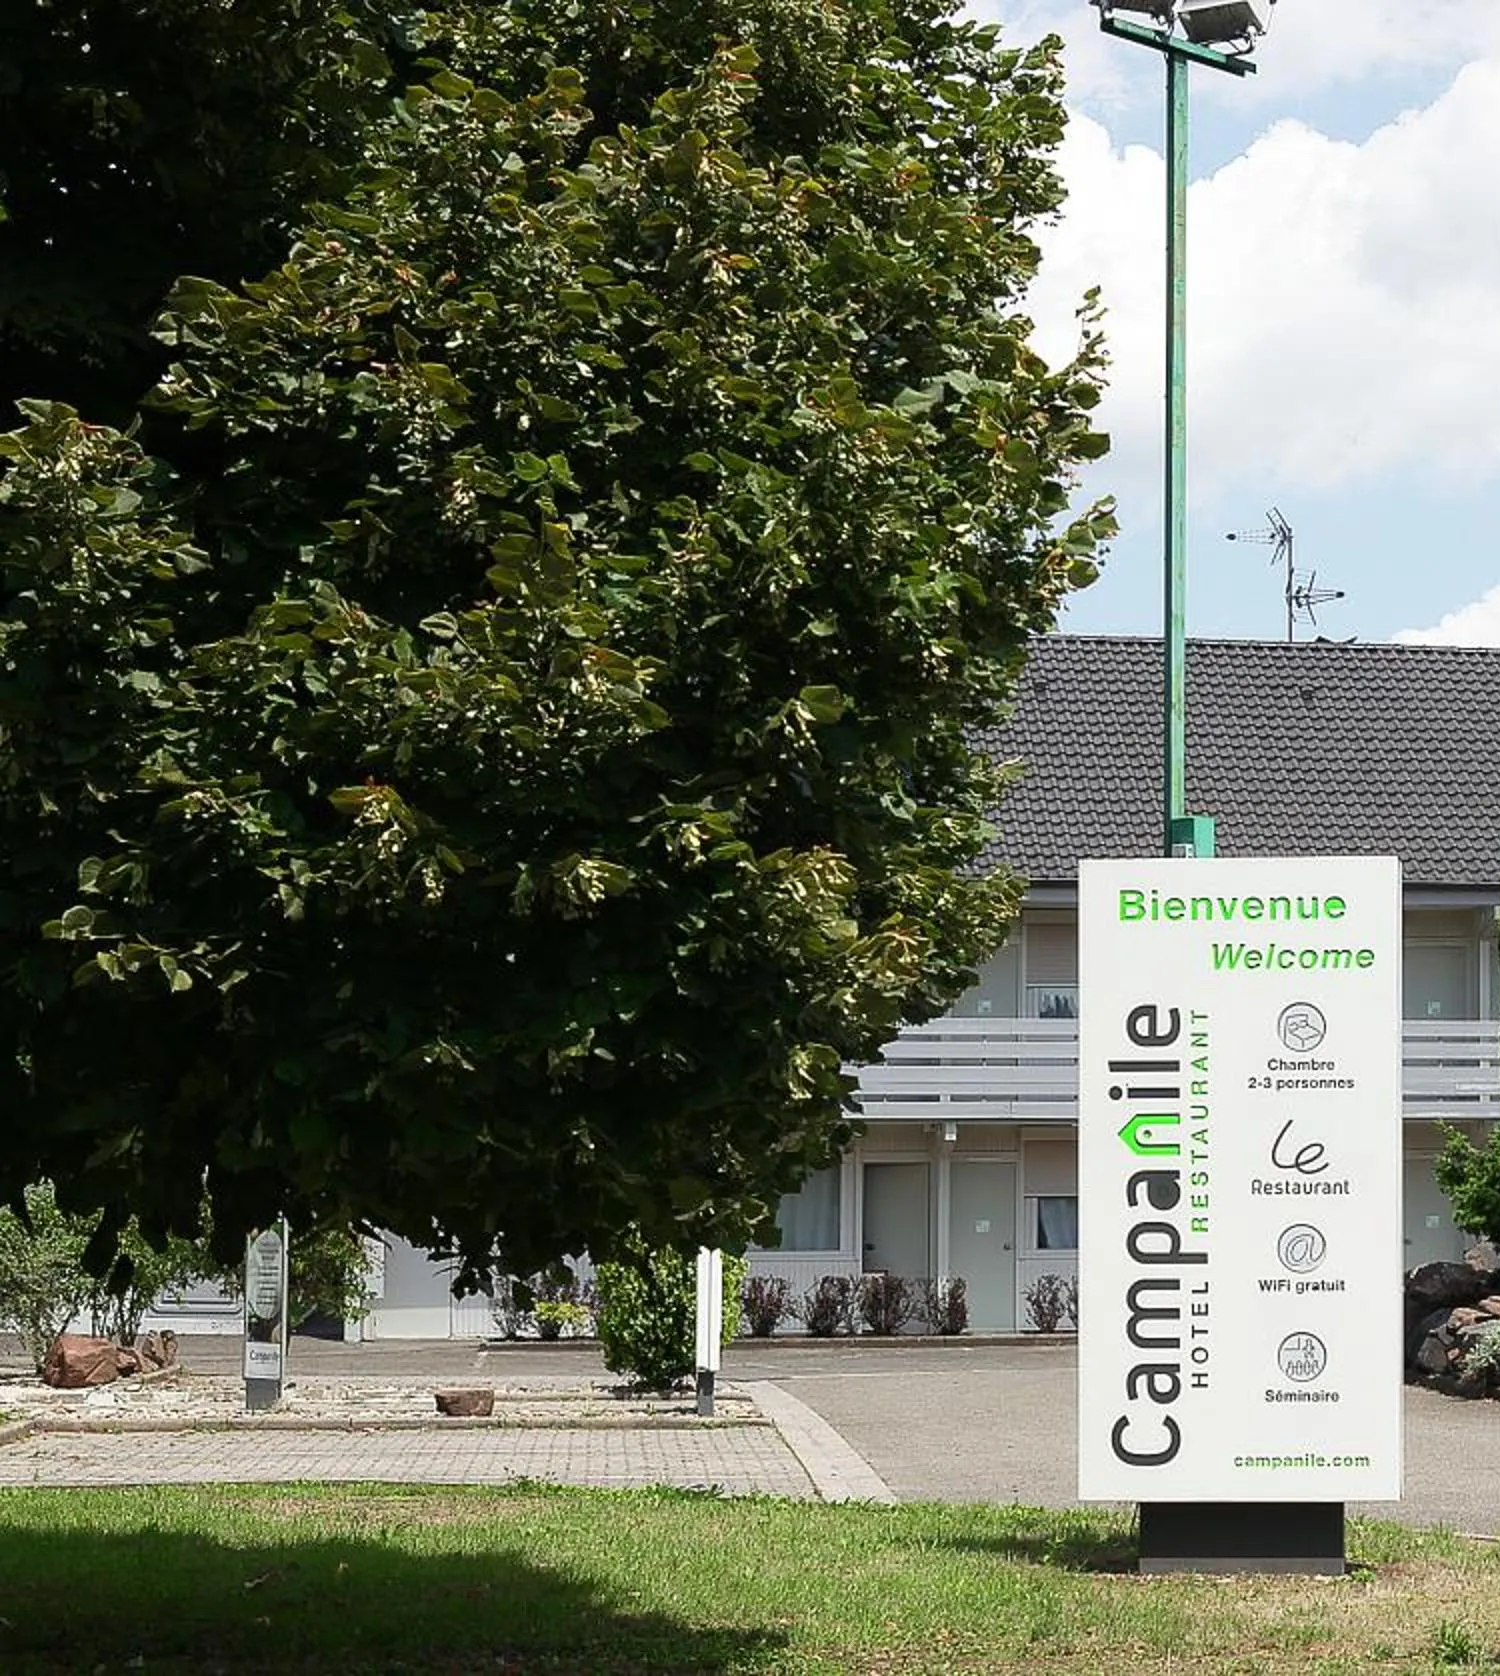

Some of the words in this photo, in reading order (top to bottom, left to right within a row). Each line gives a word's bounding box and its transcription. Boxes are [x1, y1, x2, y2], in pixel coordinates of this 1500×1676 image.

[1119, 890, 1346, 921] Bienvenue
[1212, 943, 1374, 970] Welcome
[1268, 1058, 1334, 1071] Chambre
[1247, 1076, 1273, 1090] 2-3
[1275, 1077, 1356, 1091] personnes
[1190, 1010, 1208, 1232] RESTAURANT
[1252, 1179, 1350, 1195] Restaurant
[1107, 1004, 1208, 1467] Campanile
[1258, 1279, 1292, 1293] WiFi
[1295, 1279, 1346, 1295] gratuit
[1191, 1282, 1209, 1388] HOTEL
[1265, 1390, 1339, 1402] Séminaire
[1234, 1453, 1369, 1469] campanile.com
